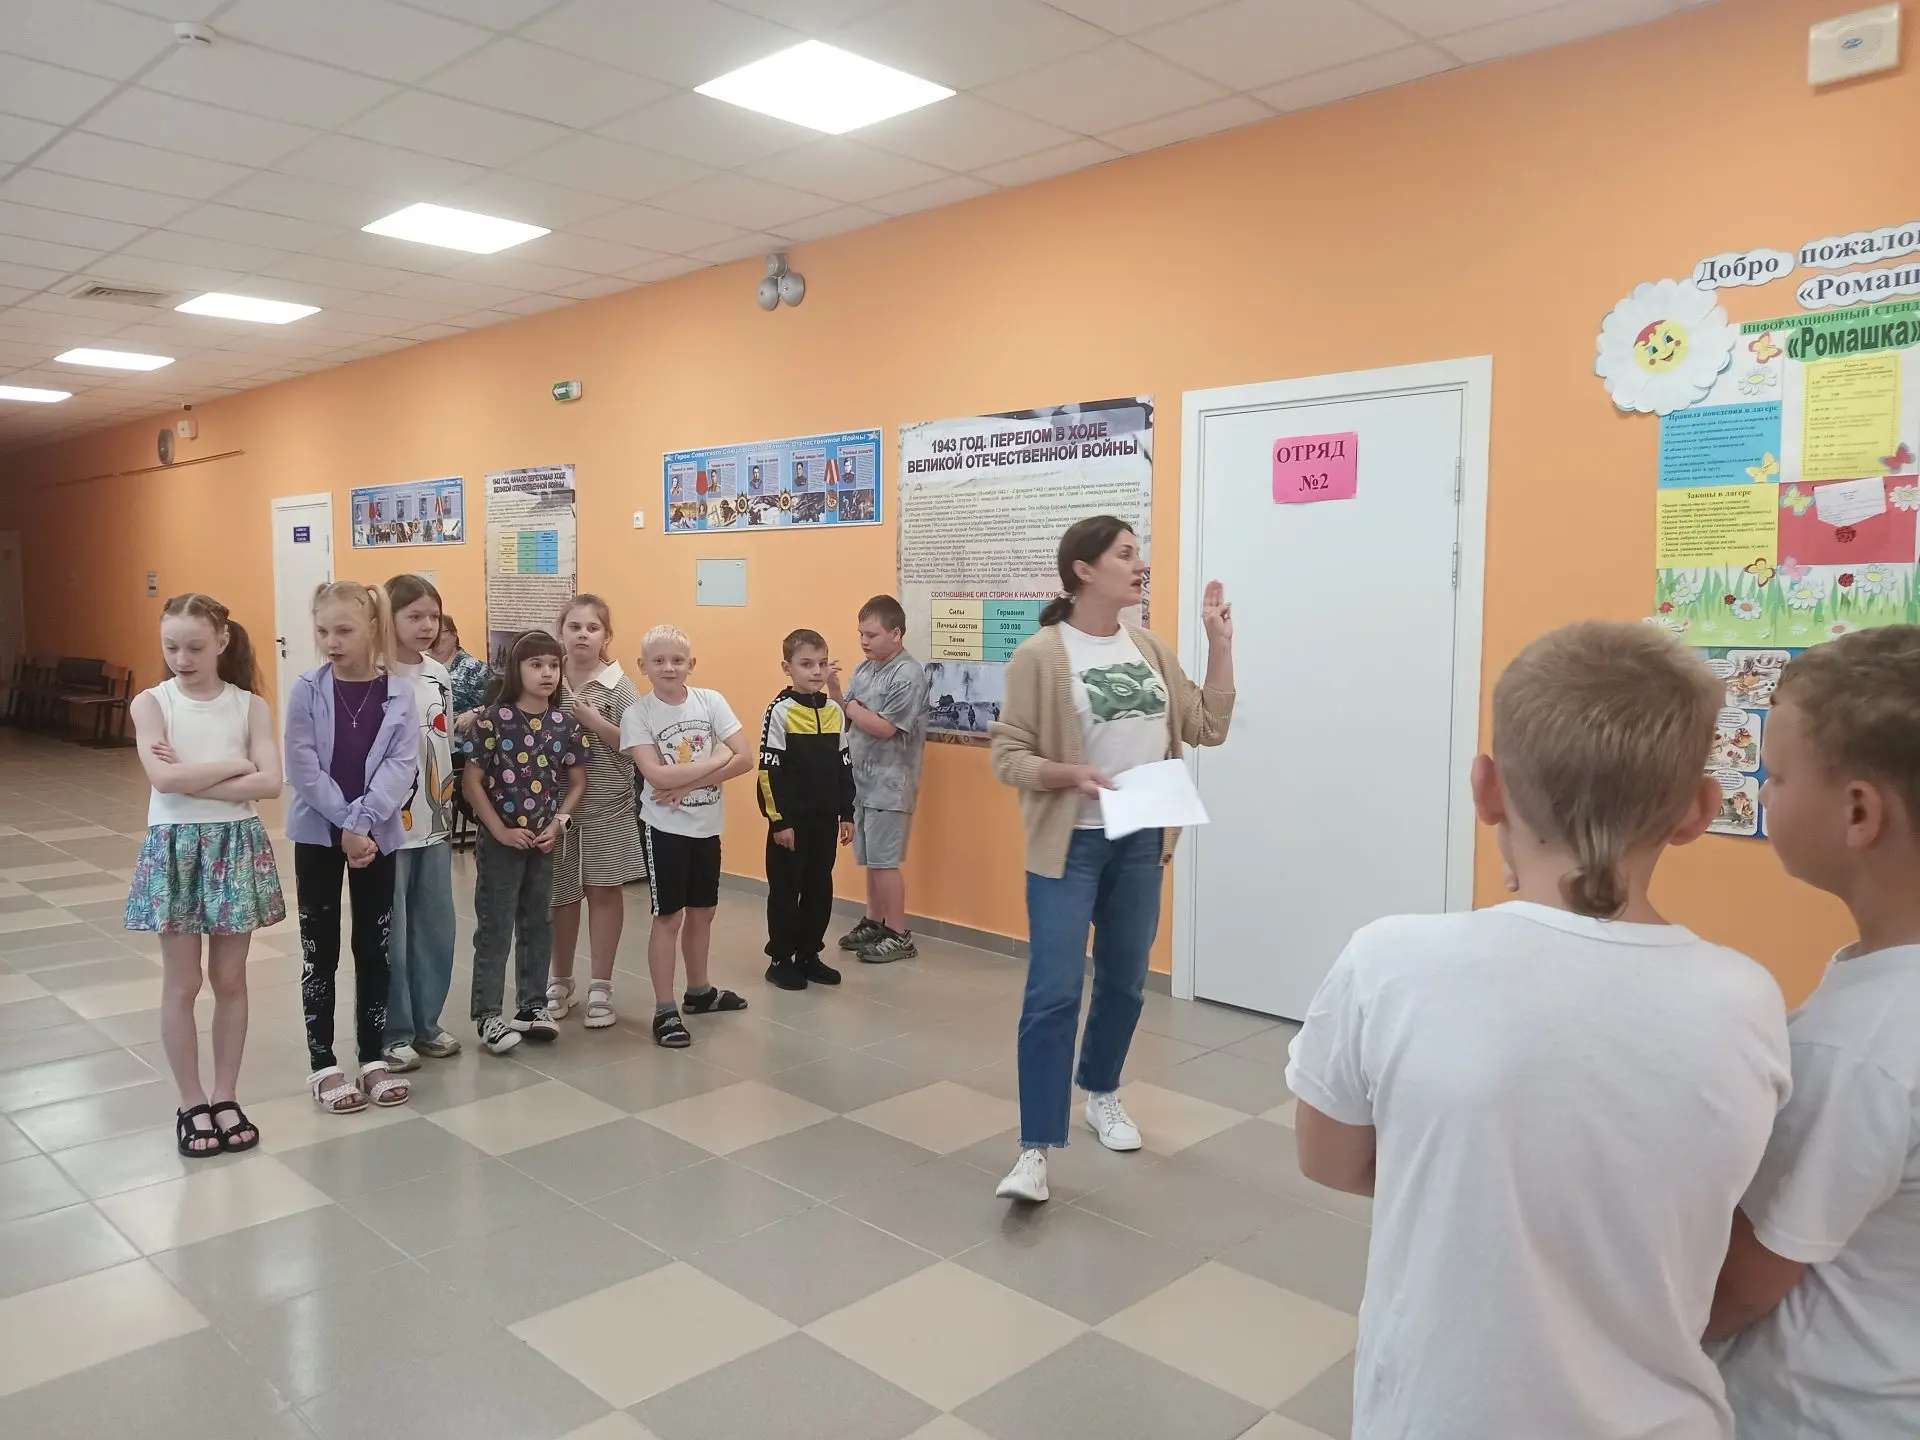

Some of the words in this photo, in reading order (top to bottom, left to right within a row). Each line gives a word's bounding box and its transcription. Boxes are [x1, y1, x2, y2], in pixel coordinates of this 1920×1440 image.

[1697, 256, 1779, 282] Добро
[1743, 308, 1870, 334] ИНФОРМАЦИОННЫЙ
[1788, 320, 1920, 359] «Ромашка»
[1669, 412, 1701, 422] Правила
[1751, 405, 1778, 415] лагере
[673, 453, 689, 461] Герои
[841, 433, 866, 442] Войны
[931, 437, 957, 454] 1943
[959, 436, 987, 452] ГОД.
[990, 425, 1052, 448] ПЕРЕЛОМ
[1055, 426, 1065, 439] В
[1068, 421, 1108, 439] ХОДЕ
[907, 453, 963, 474] ВЕЛИКОЙ
[965, 441, 1078, 468] ОТЕЧЕСТВЕННОЙ
[1081, 438, 1138, 459] ВОЙНЫ
[1277, 441, 1345, 463] ОТРЯД
[548, 480, 565, 489] ВОЙНЫ
[1299, 473, 1329, 491] №2
[1725, 490, 1751, 498] лагере
[975, 590, 988, 598] СИЛ
[988, 590, 1014, 598] СТОРОН
[1014, 590, 1019, 598] К
[1020, 590, 1045, 598] НАЧАЛУ
[949, 608, 965, 616] Силы
[997, 608, 1025, 617] Германия
[959, 622, 978, 630] состав
